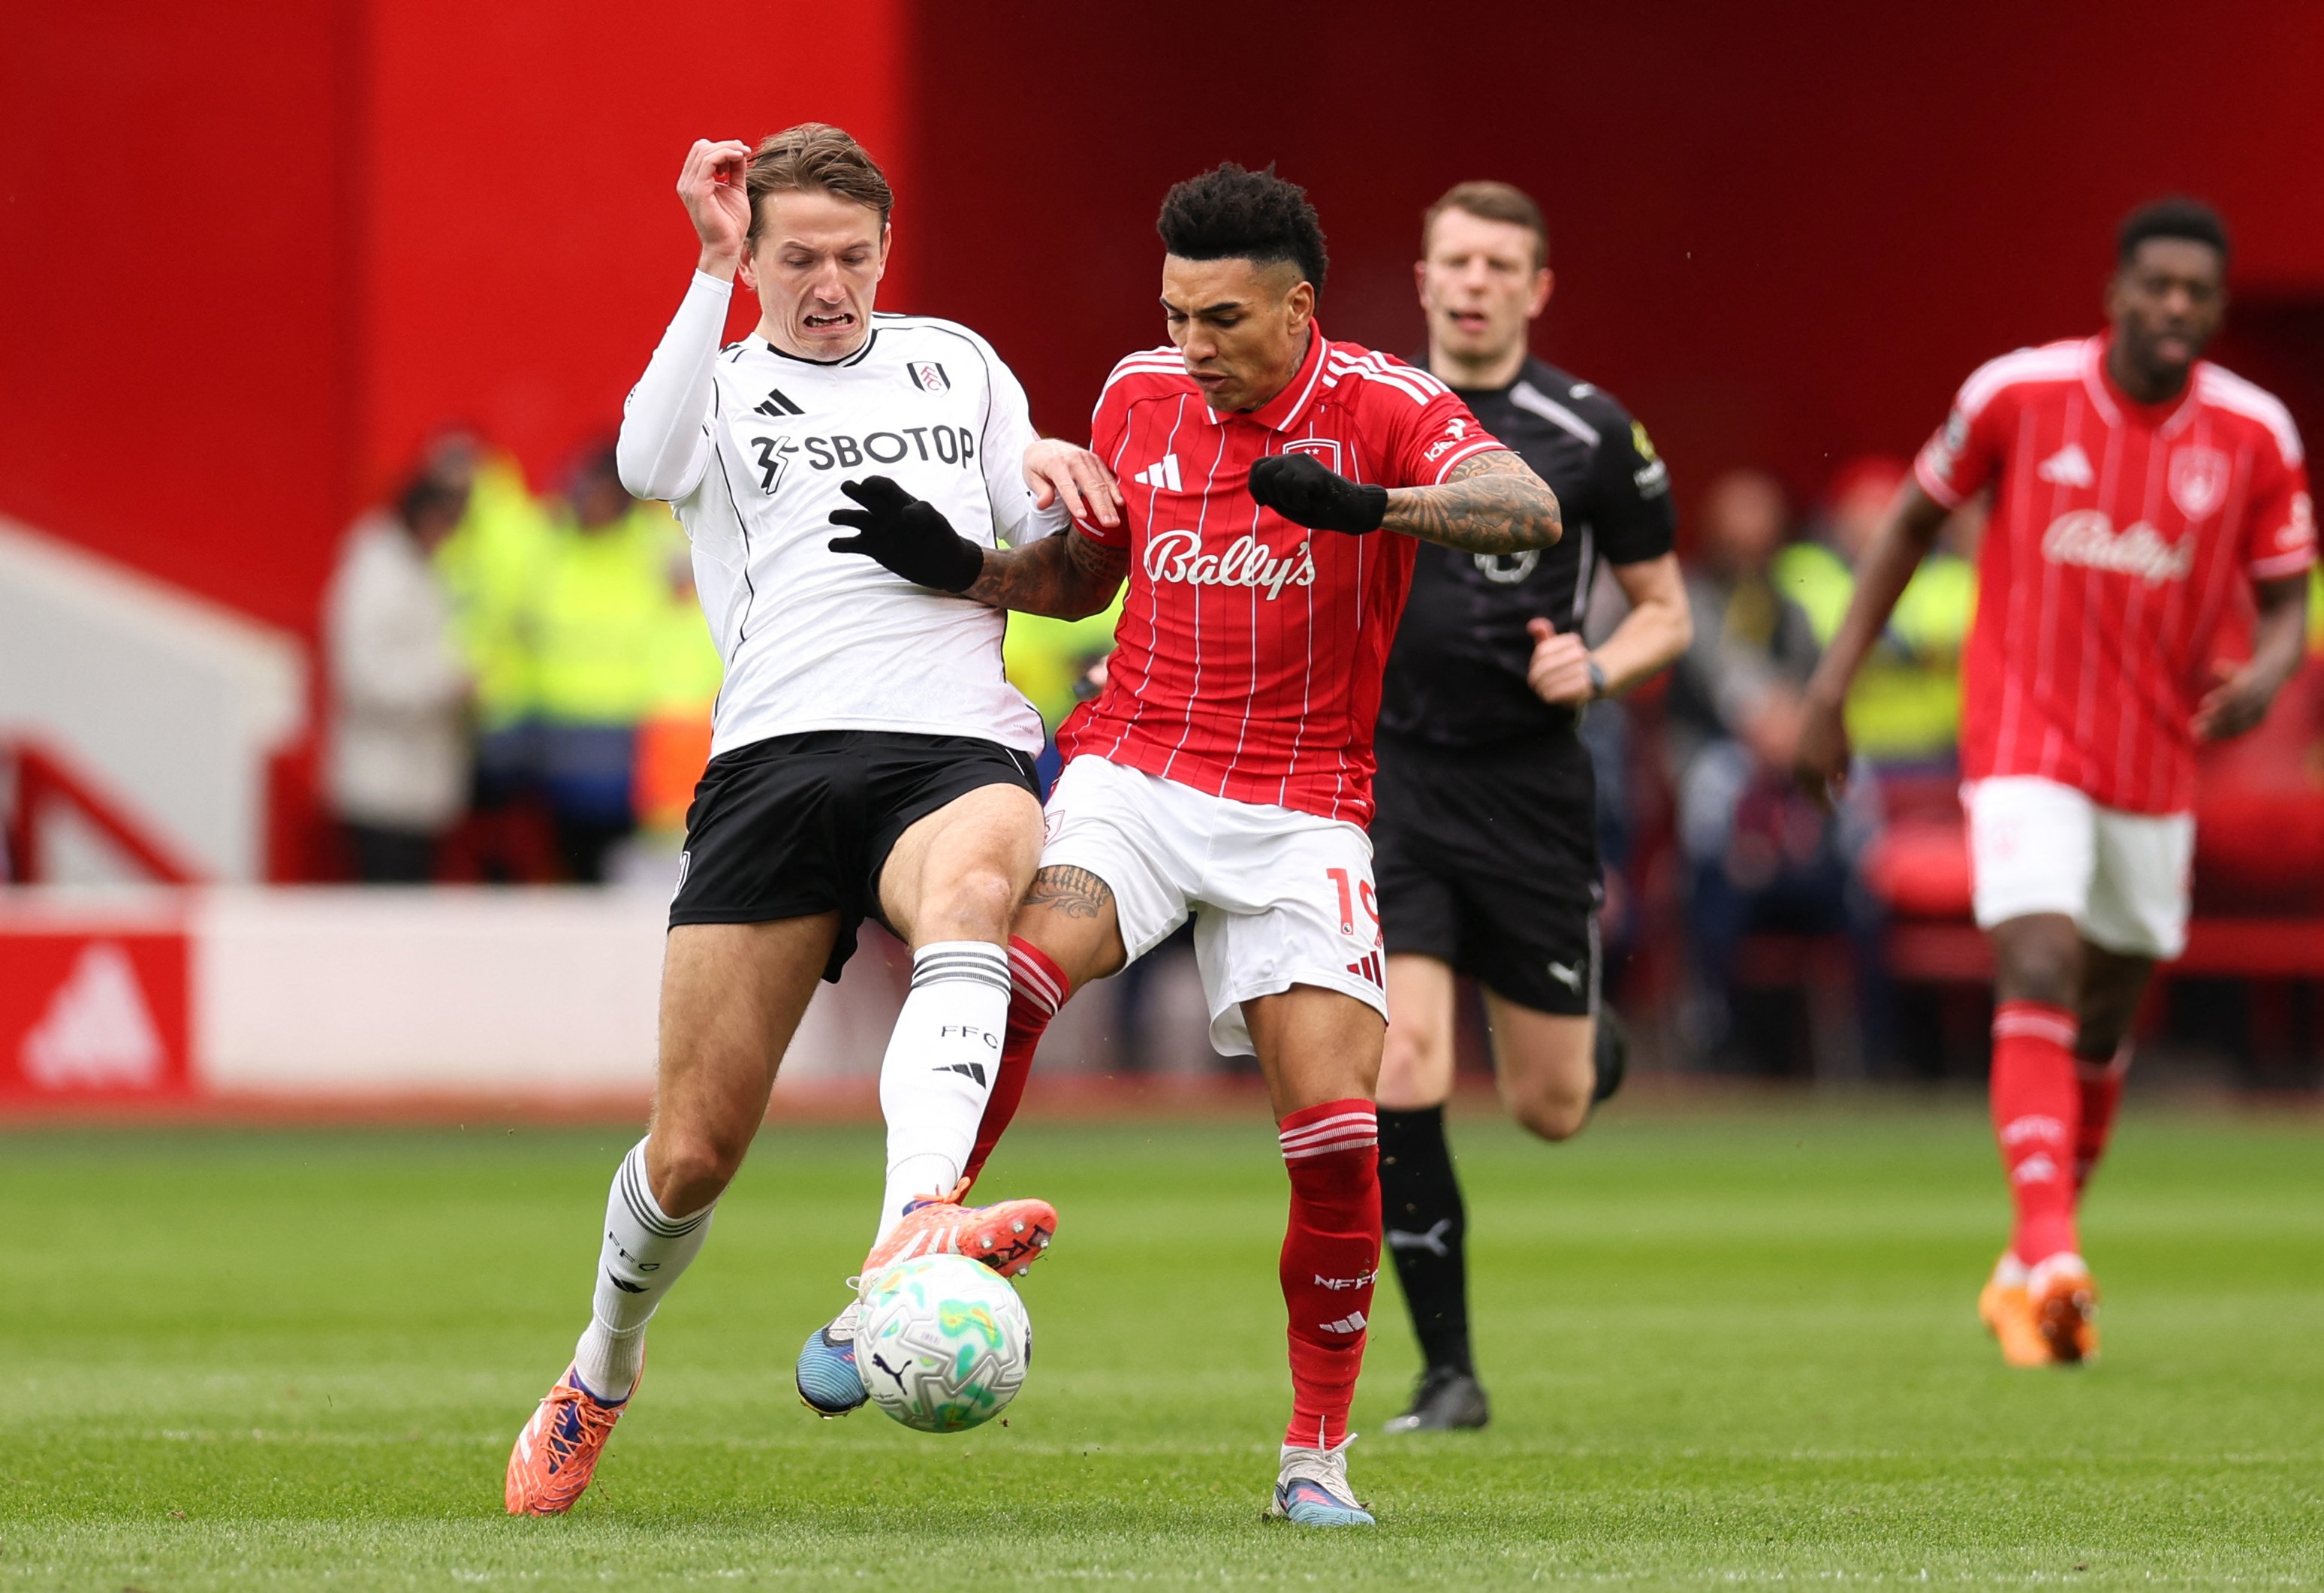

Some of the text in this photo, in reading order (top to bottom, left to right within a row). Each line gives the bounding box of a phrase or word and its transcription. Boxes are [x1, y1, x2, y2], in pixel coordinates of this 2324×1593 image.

[921, 366, 942, 391] FFC
[804, 425, 974, 470] SBOTOP
[1143, 529, 1316, 601] Bally's
[1326, 867, 1384, 949] 19
[941, 1025, 999, 1049] FFC
[609, 1231, 660, 1272] FFC
